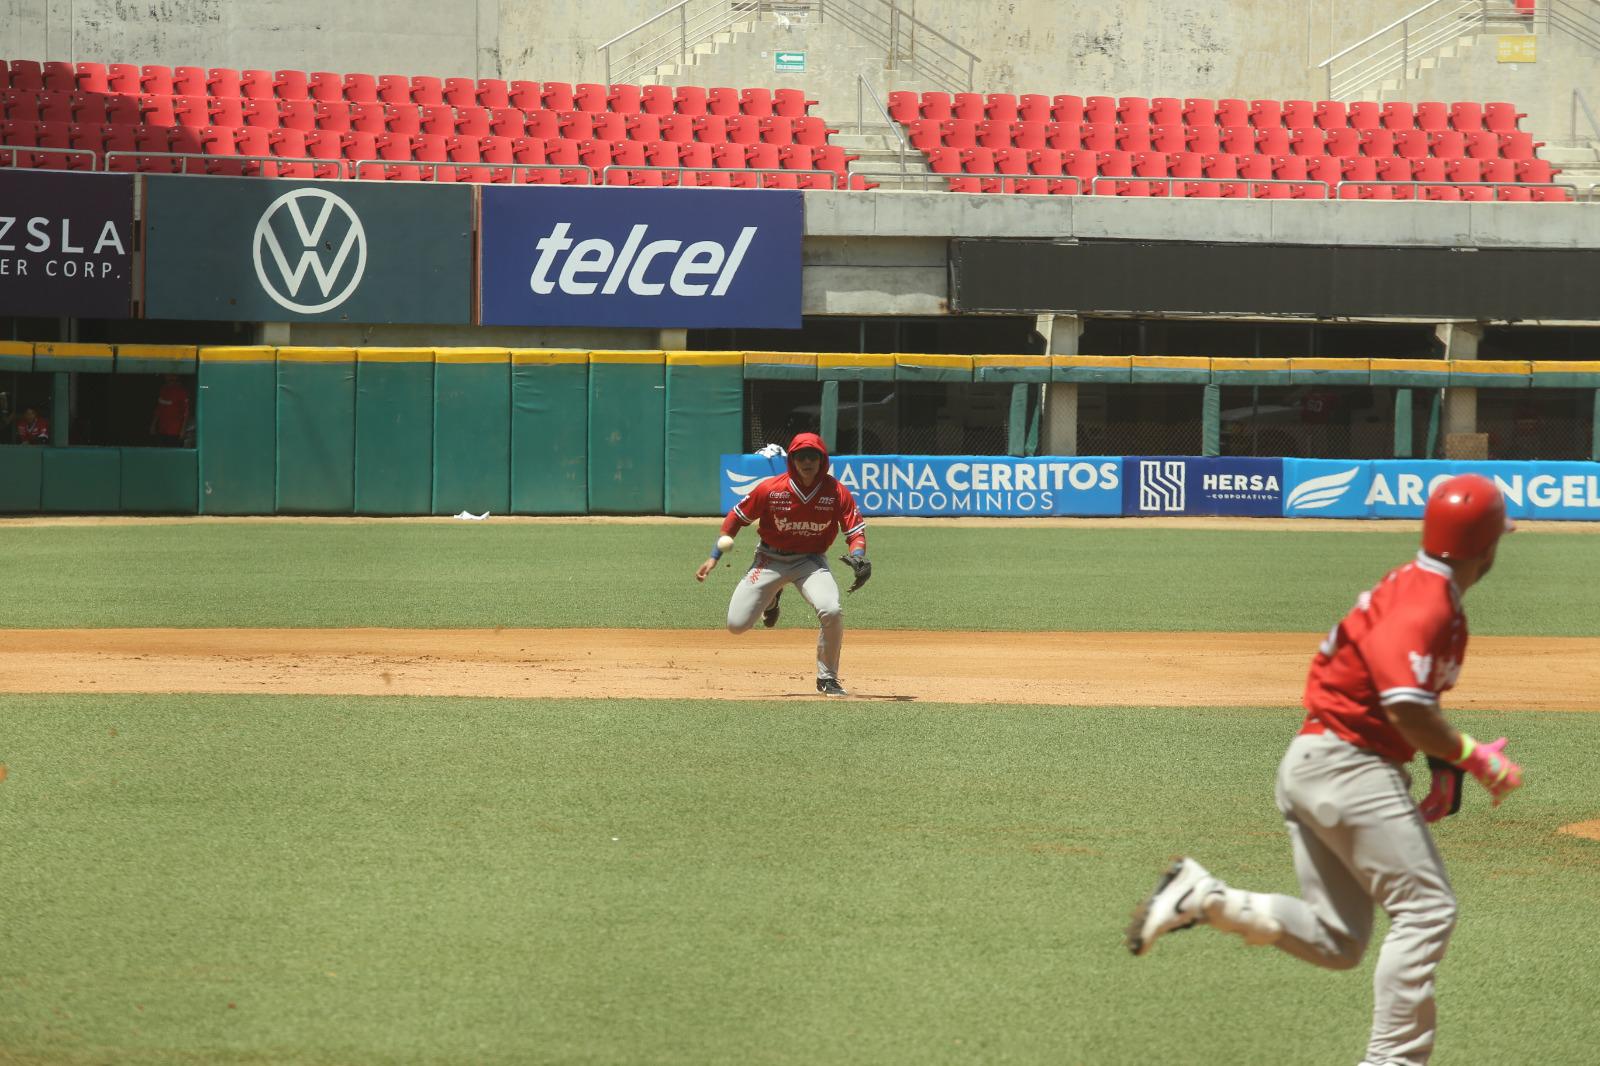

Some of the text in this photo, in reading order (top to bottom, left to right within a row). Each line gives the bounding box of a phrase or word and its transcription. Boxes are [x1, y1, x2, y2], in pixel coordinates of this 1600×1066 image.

[45, 260, 121, 279] CORP.
[530, 222, 758, 297] telcel
[827, 463, 1119, 491] ARINA CERRITOS
[1202, 474, 1280, 492] HERSA
